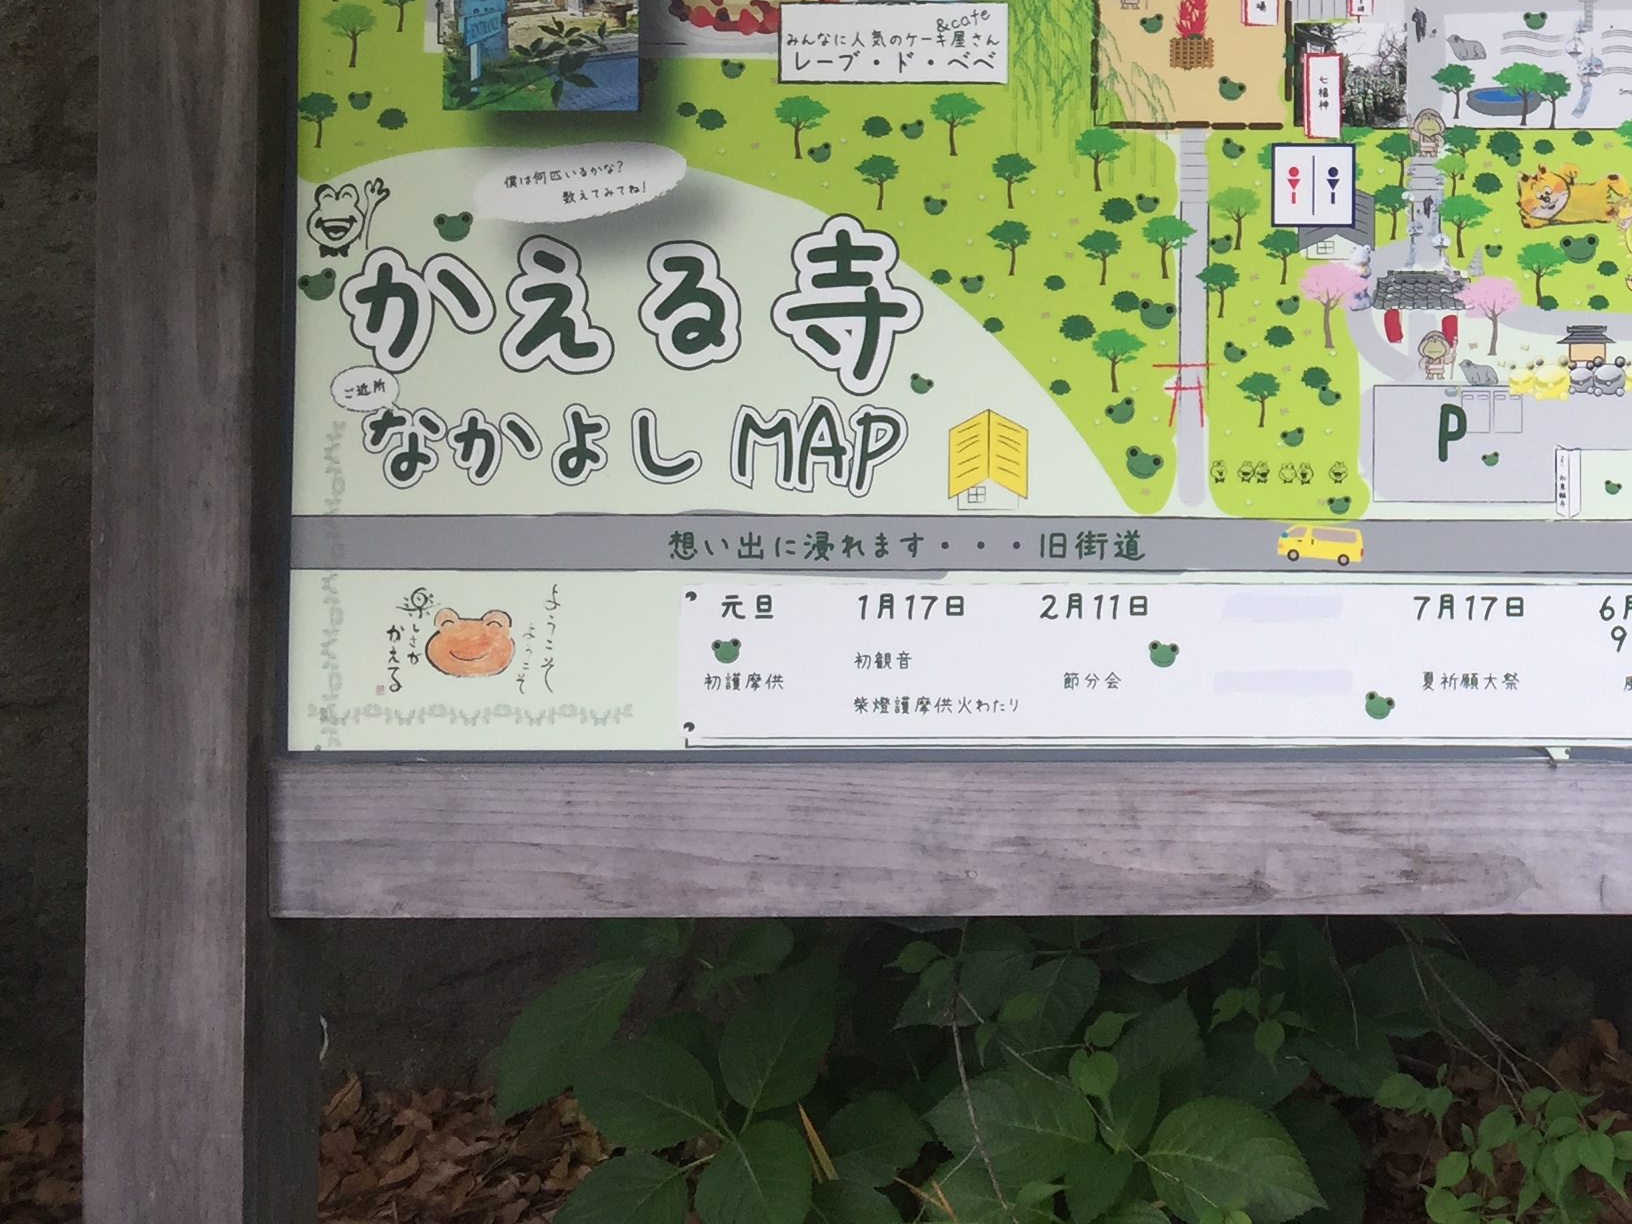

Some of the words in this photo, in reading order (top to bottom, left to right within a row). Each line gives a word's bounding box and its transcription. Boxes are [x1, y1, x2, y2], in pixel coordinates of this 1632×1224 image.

[784, 26, 1003, 50] みんなに人気のケーキ屋さん
[795, 49, 997, 74] レーブ・ド・ベベ
[345, 216, 922, 393] かえる寺
[340, 376, 390, 400] ご近所
[1437, 403, 1468, 463] P
[362, 404, 706, 490] なかよし
[730, 398, 910, 498] MAP
[721, 594, 774, 620] 元旦
[857, 592, 965, 621] 1月17日
[1039, 592, 1148, 621] 2月11日
[1413, 593, 1525, 622] 7月17日
[385, 623, 406, 694] かえる
[853, 650, 913, 670] 初観音
[703, 671, 784, 692] 初護摩供
[1063, 671, 1122, 691] 節分会
[1422, 671, 1520, 692] 夏祈願大祭
